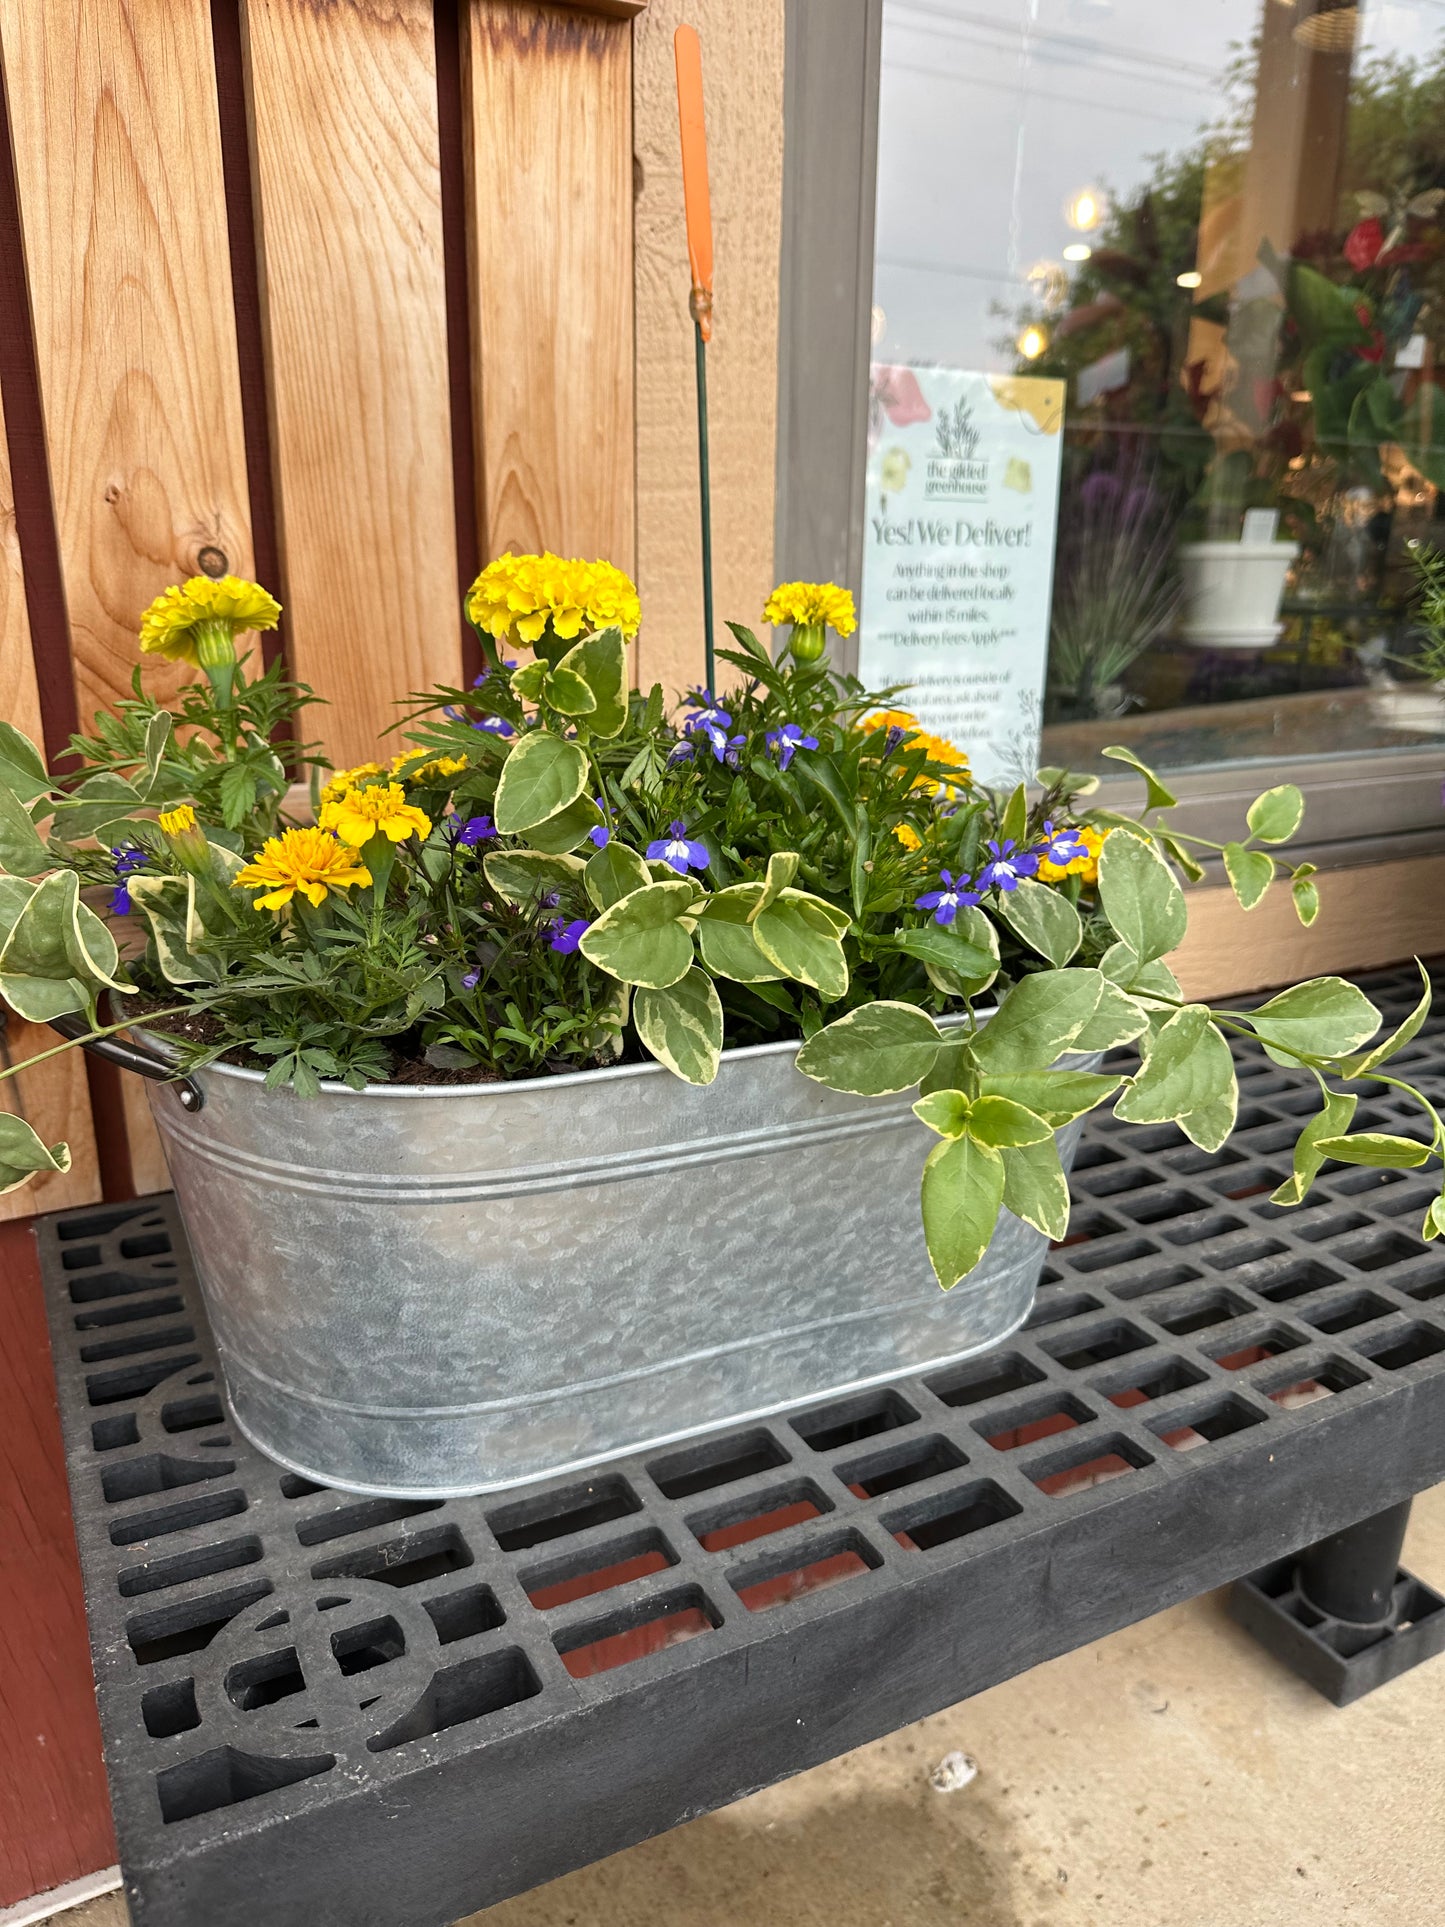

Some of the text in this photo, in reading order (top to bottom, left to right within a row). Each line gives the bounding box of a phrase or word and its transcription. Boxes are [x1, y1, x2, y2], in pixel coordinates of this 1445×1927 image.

[927, 459, 948, 480] the
[924, 477, 987, 496] greenhouse
[871, 516, 1032, 548] Yes! We Deliver!
[893, 562, 945, 581] Anything
[959, 562, 979, 578] the
[981, 562, 1010, 581] shop
[886, 583, 1016, 603] can be delivered locally
[907, 608, 943, 624] within
[942, 629, 969, 647] Fees
